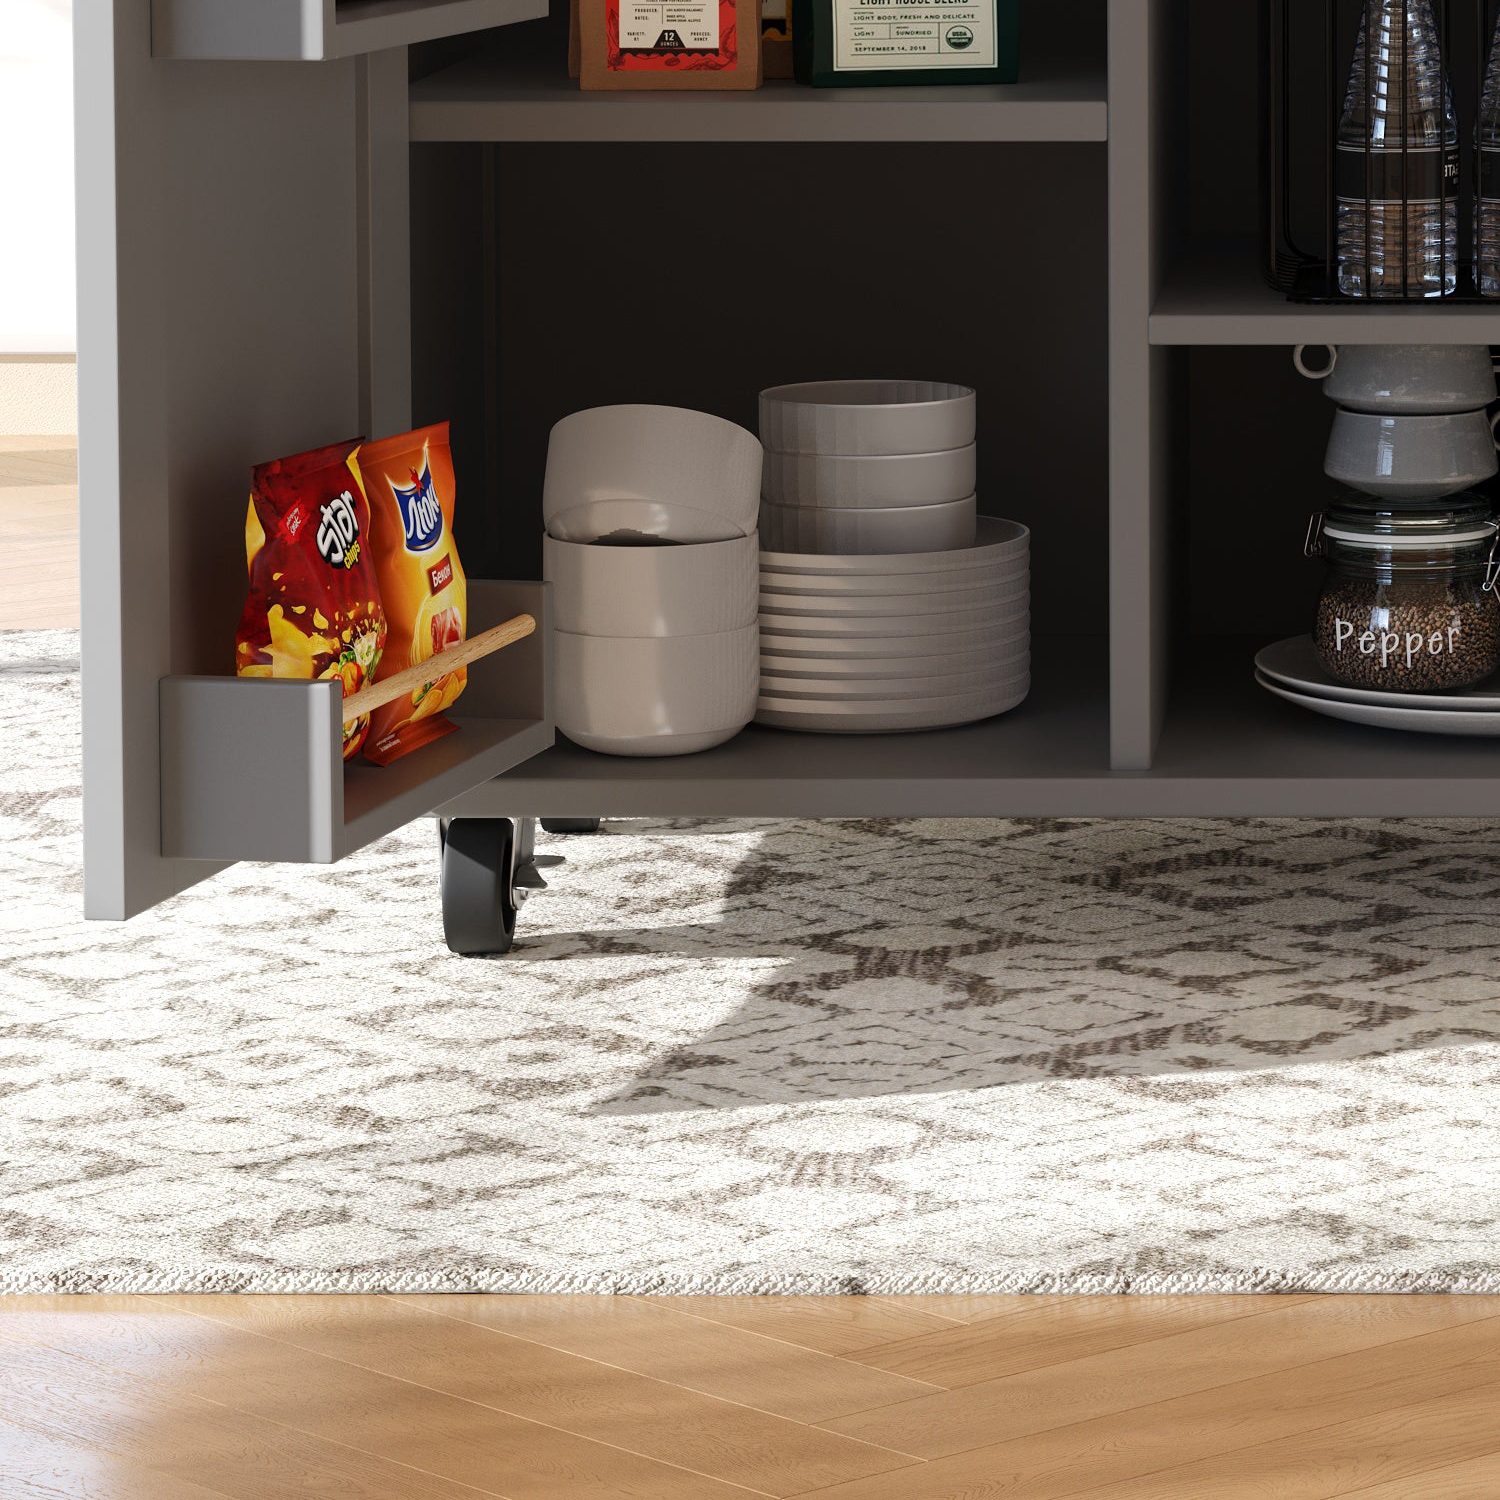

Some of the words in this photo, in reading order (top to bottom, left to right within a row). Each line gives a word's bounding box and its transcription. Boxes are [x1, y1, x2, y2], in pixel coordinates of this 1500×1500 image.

[664, 32, 675, 41] 12
[343, 540, 361, 570] chips
[1334, 617, 1461, 669] Pepper
